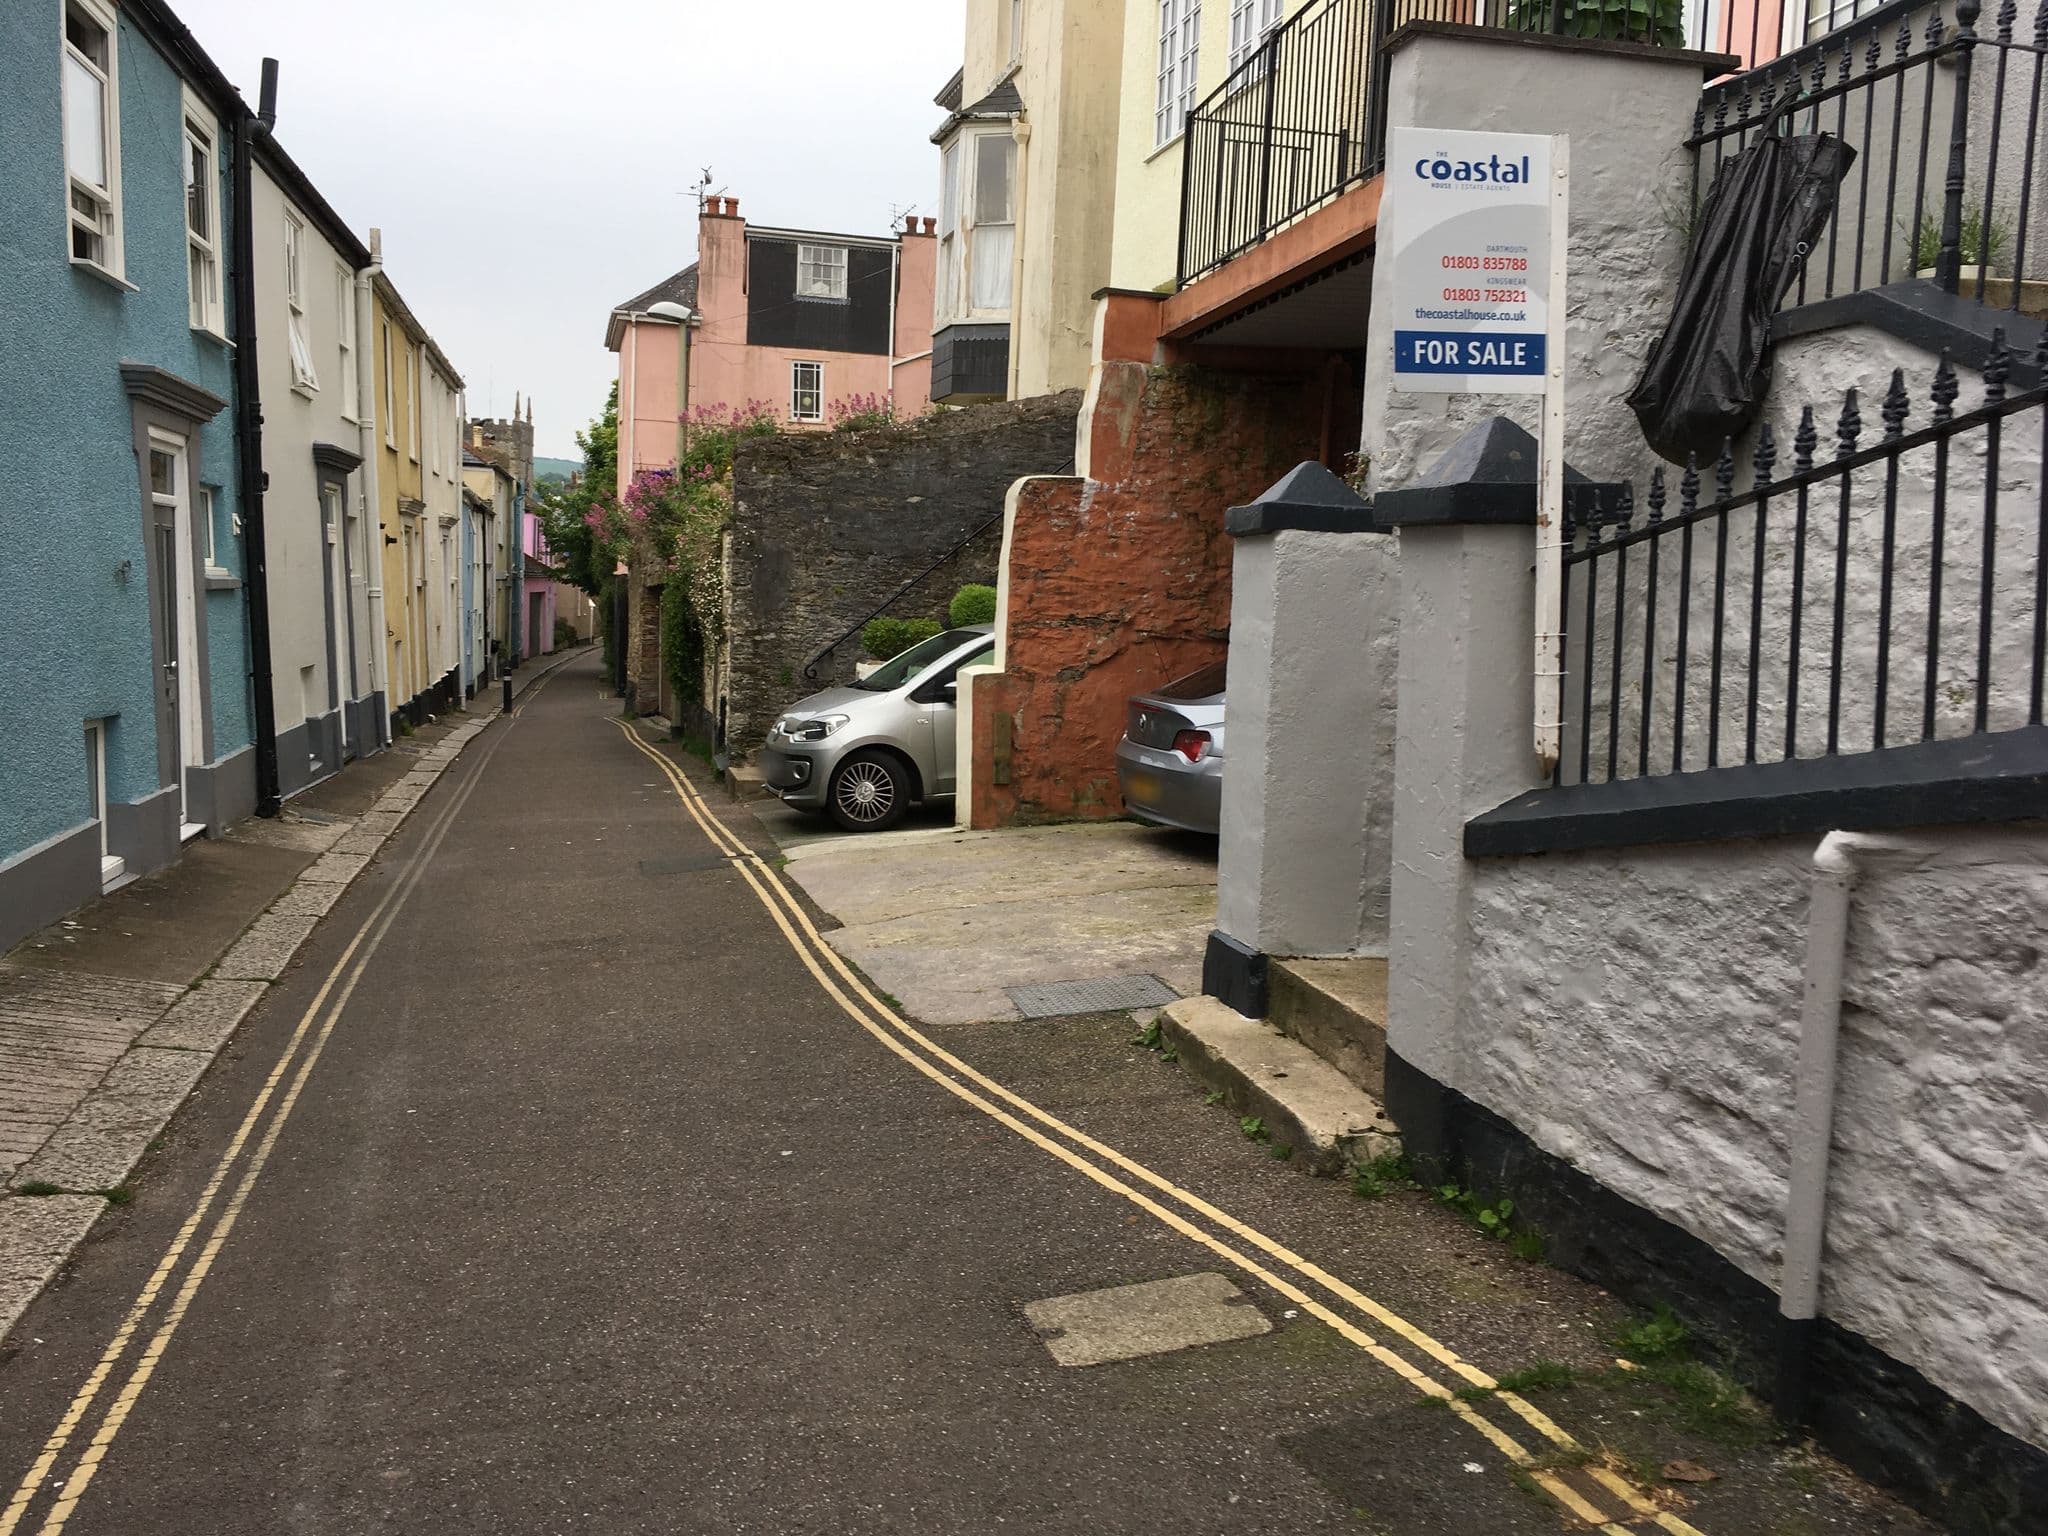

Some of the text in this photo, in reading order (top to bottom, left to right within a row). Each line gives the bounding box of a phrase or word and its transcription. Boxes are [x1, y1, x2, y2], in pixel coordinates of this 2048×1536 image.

[1415, 154, 1529, 183] coastal
[1486, 245, 1528, 253] DARTMOUTH
[1441, 255, 1528, 271] 01803 835788
[1486, 277, 1527, 285] KINGSWEAR
[1443, 287, 1527, 303] 01803 752321
[1415, 307, 1526, 321] thecoastalhouse.co.uk
[1415, 340, 1527, 366] FOR SALE
